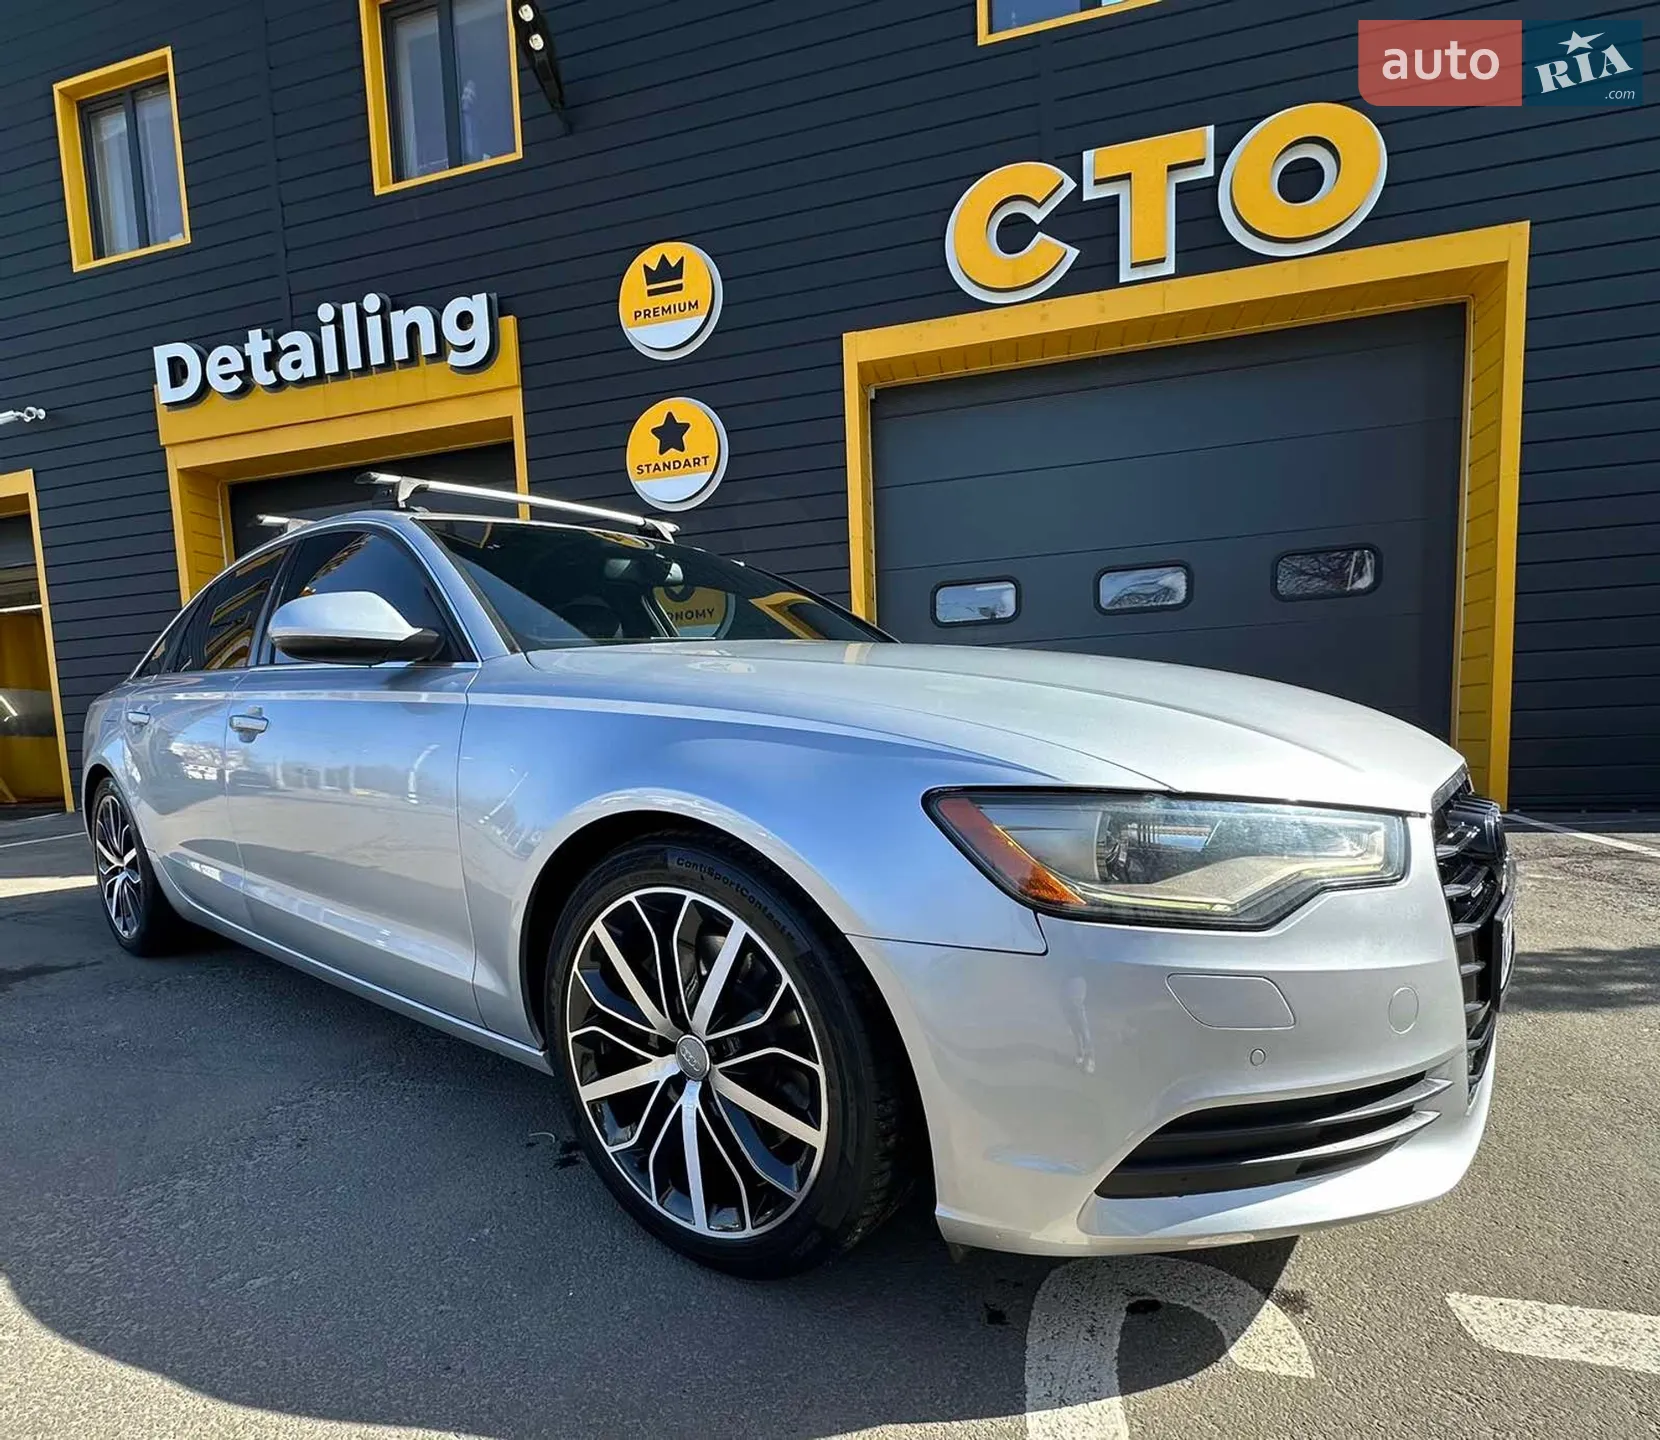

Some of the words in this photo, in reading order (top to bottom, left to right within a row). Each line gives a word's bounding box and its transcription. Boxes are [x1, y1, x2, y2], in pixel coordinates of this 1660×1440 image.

[633, 299, 699, 321] PREMIUM
[153, 292, 492, 405] Detailing
[636, 455, 710, 475] STANDART
[666, 607, 716, 622] ONOMY
